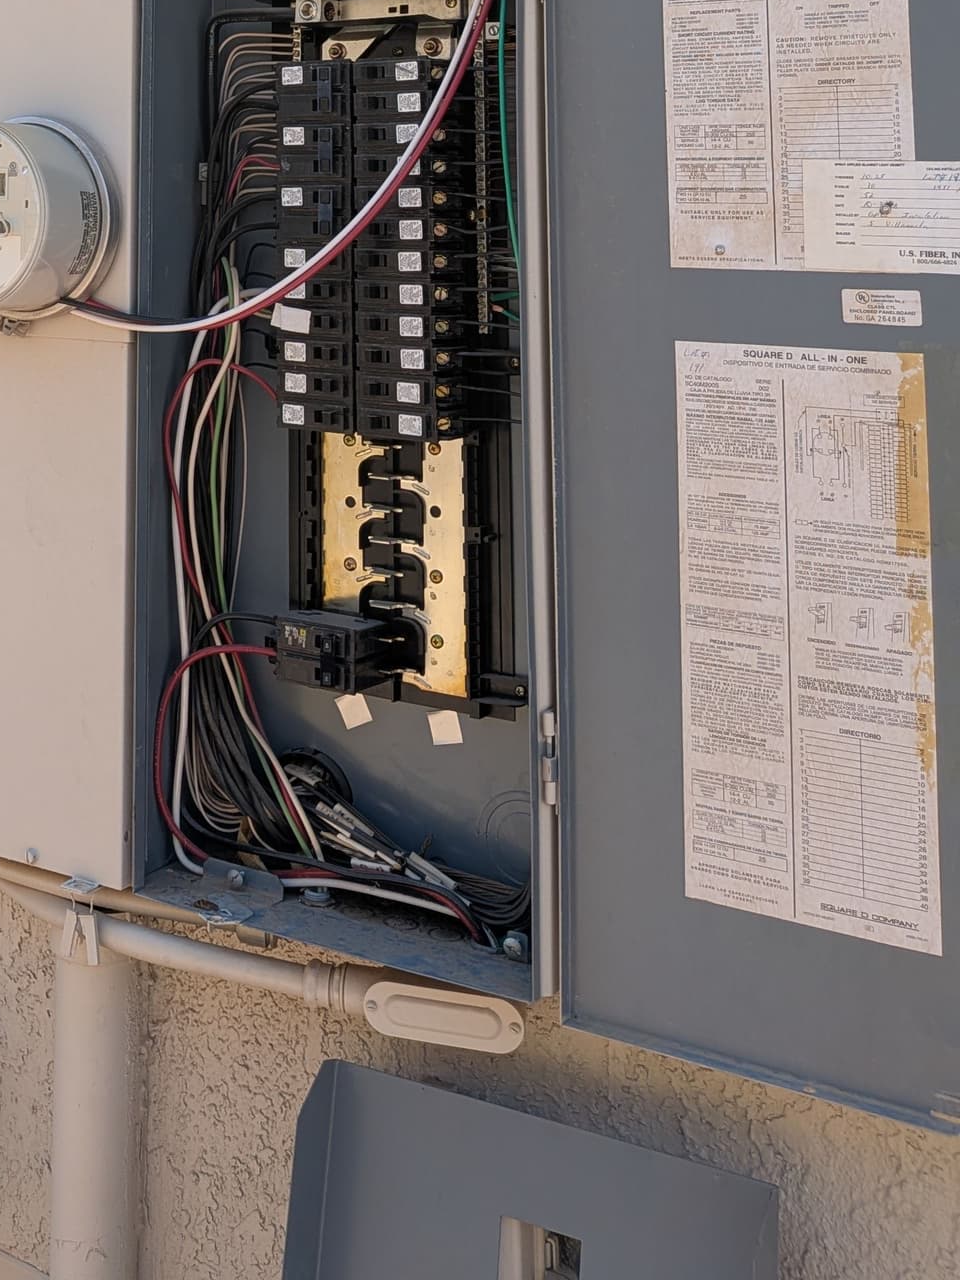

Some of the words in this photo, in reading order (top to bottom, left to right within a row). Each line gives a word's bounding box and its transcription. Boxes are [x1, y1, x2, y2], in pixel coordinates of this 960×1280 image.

[743, 349, 783, 360] SQUARE
[800, 353, 819, 361] ALL
[828, 355, 837, 363] IN
[846, 355, 867, 365] ONE
[723, 360, 763, 368] DISPOSITIVO
[775, 362, 806, 370] ENTRADA
[817, 365, 849, 373] SERVICIO
[850, 367, 892, 375] COMBINADO
[839, 728, 881, 740] DIRECTORIO
[820, 902, 858, 917] SQUARE
[861, 910, 869, 919] D
[871, 914, 919, 929] COMPANY
